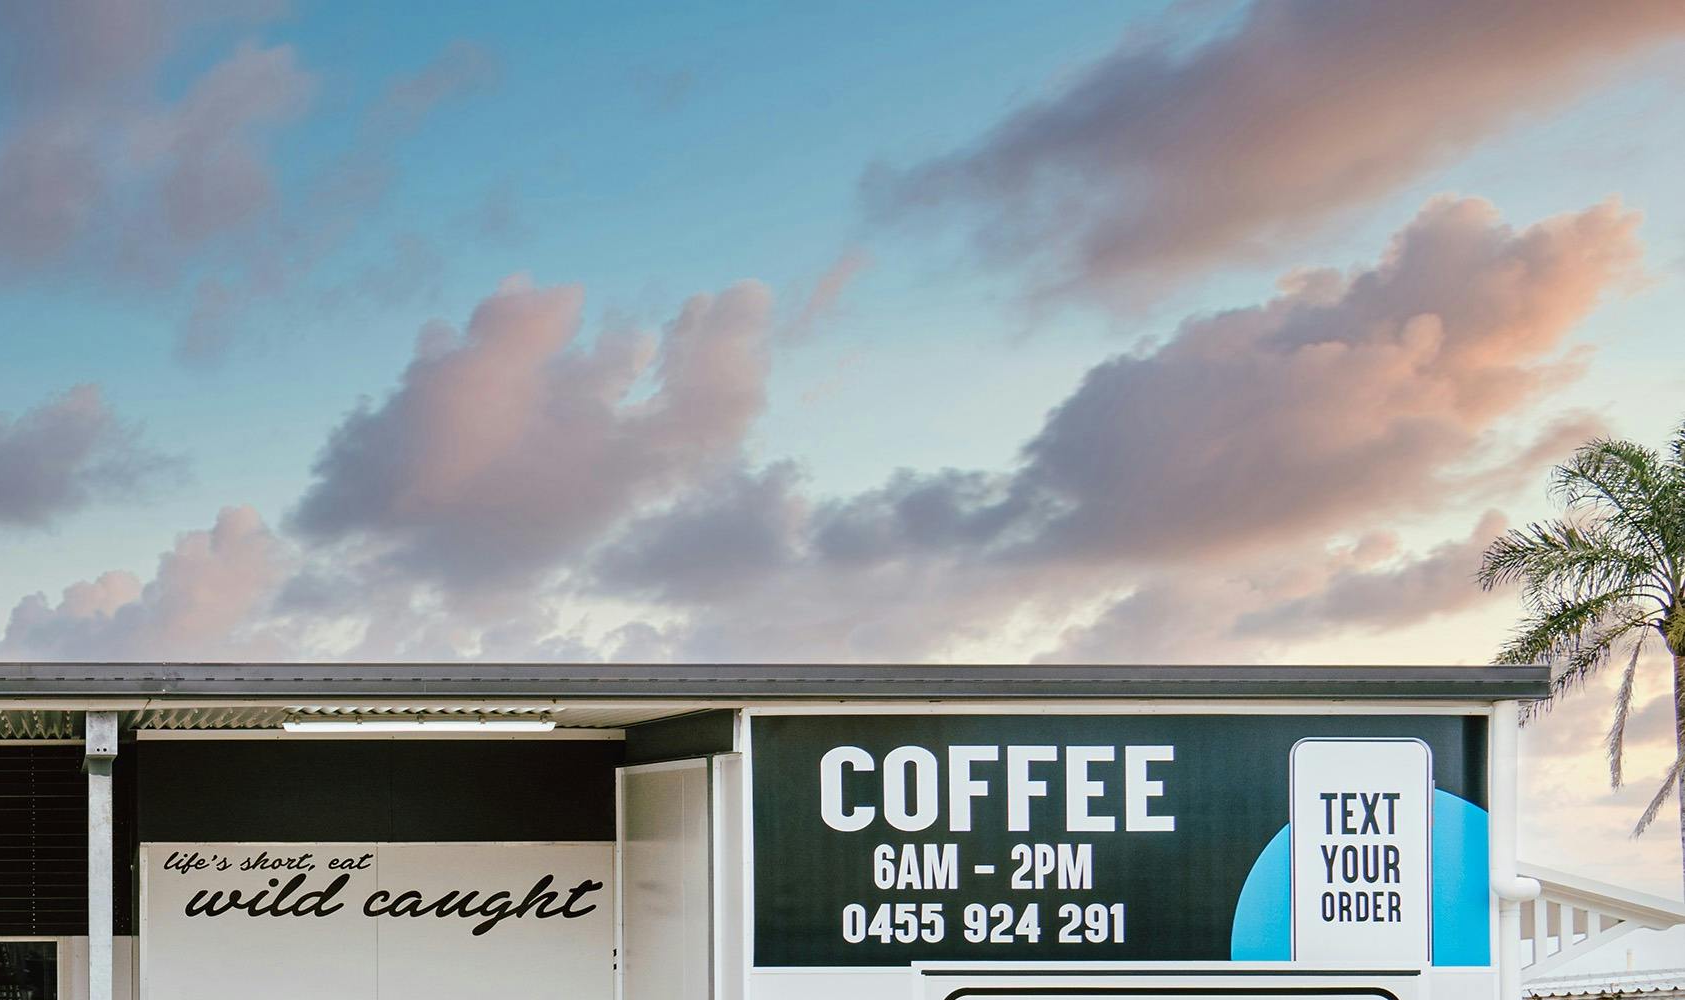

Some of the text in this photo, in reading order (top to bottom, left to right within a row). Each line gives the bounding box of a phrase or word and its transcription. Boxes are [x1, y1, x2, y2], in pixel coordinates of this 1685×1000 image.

[820, 744, 1175, 833] COFFEE
[1320, 791, 1401, 836] TEXT
[163, 851, 375, 874] life's short, eat
[873, 843, 959, 891] 6AM
[1010, 843, 1094, 891] 2PM
[1320, 844, 1401, 884] YOUR
[184, 872, 604, 936] wild caught
[841, 902, 1127, 945] 0455 924 291
[1321, 890, 1403, 923] ORDER
